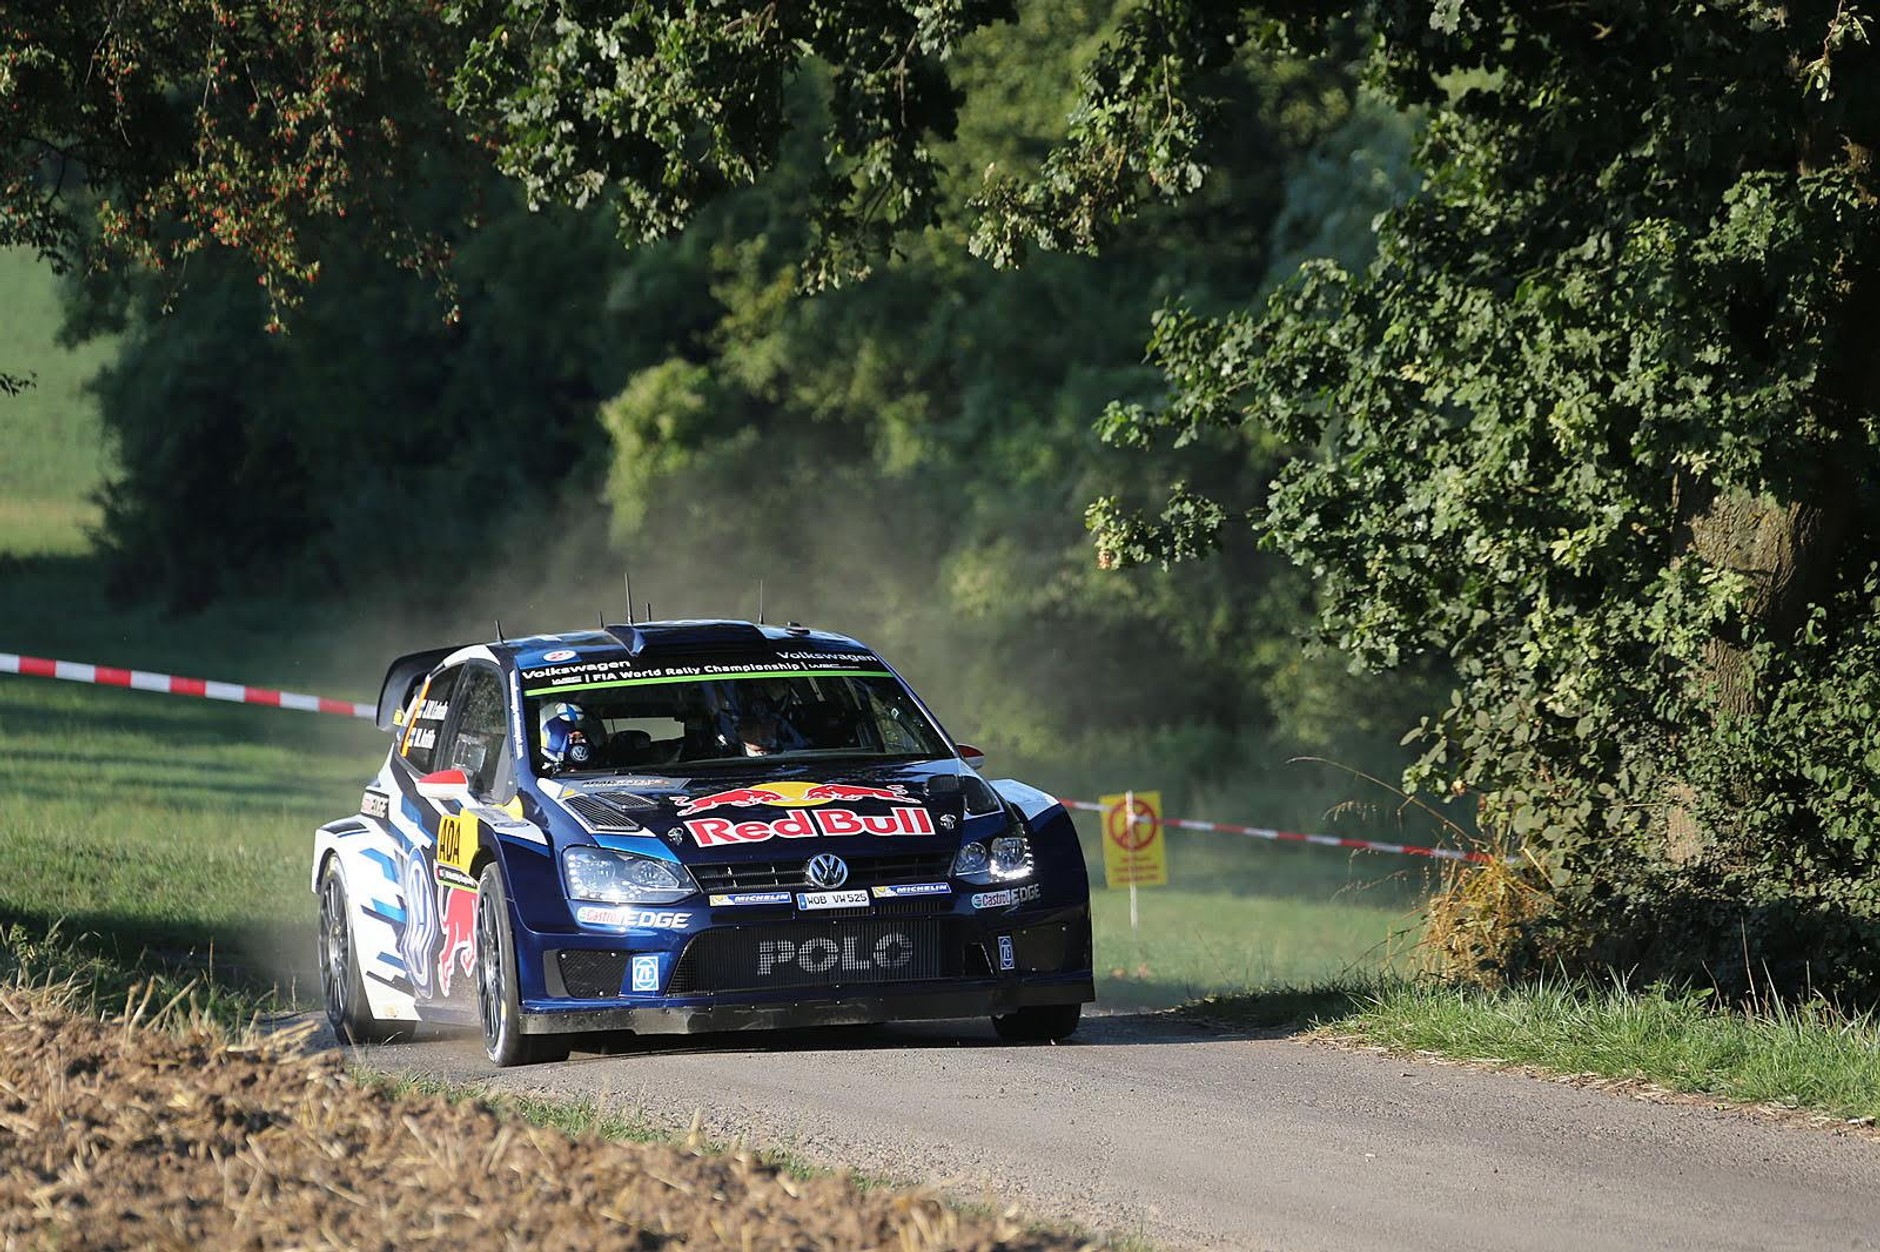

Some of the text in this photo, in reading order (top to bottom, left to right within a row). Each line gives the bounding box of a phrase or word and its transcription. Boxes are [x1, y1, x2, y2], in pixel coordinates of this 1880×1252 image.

[776, 651, 878, 662] Volkswagen
[521, 661, 631, 680] Volkswagen
[592, 672, 617, 682] FIA
[619, 668, 662, 680] World
[665, 666, 700, 675] Rally
[703, 662, 800, 674] Championship
[687, 808, 935, 847] Red Bull
[896, 884, 947, 894] MICHELIN
[982, 884, 1041, 907] Castrol EDGE
[734, 894, 789, 903] MICHELIN
[807, 894, 867, 906] WOB VW 525
[624, 911, 693, 929] EDGE
[757, 933, 913, 976] POLO
